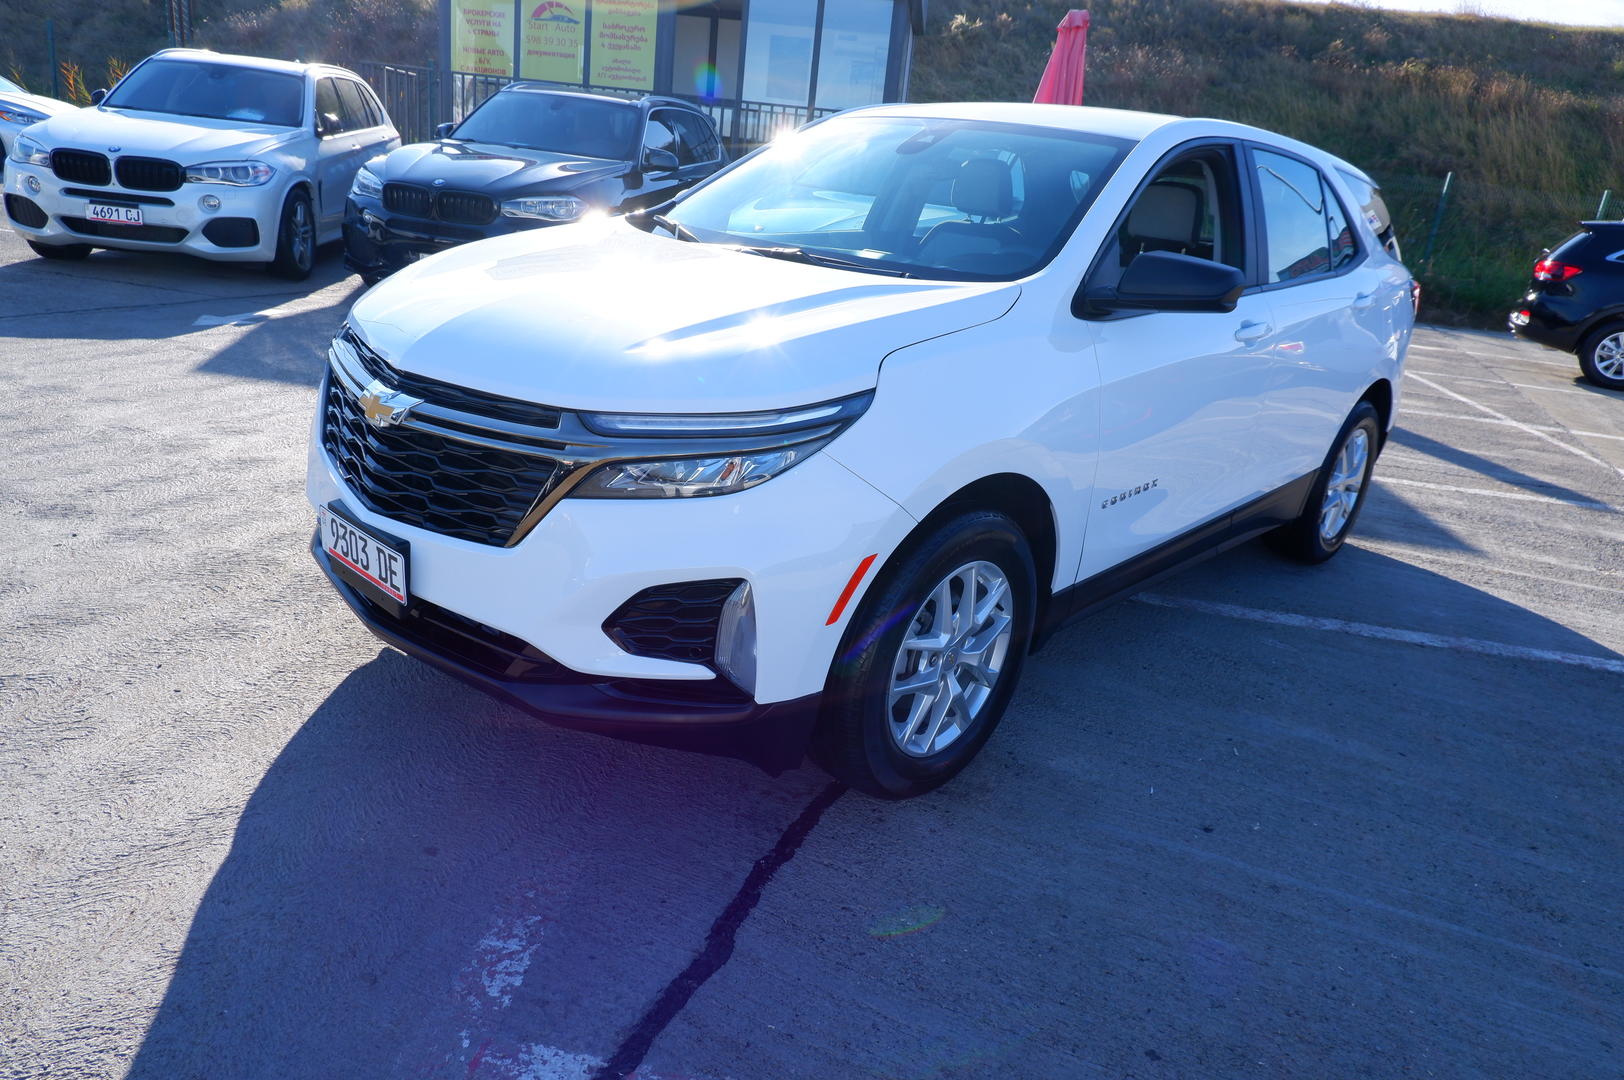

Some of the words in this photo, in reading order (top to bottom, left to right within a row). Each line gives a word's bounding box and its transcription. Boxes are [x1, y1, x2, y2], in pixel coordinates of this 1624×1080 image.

[527, 20, 548, 31] Start
[554, 23, 576, 33] Auto
[92, 206, 120, 221] 4691
[125, 209, 141, 222] CJ
[1101, 478, 1159, 509] EQUINOX
[330, 517, 370, 571] 9303
[376, 546, 401, 592] DE
